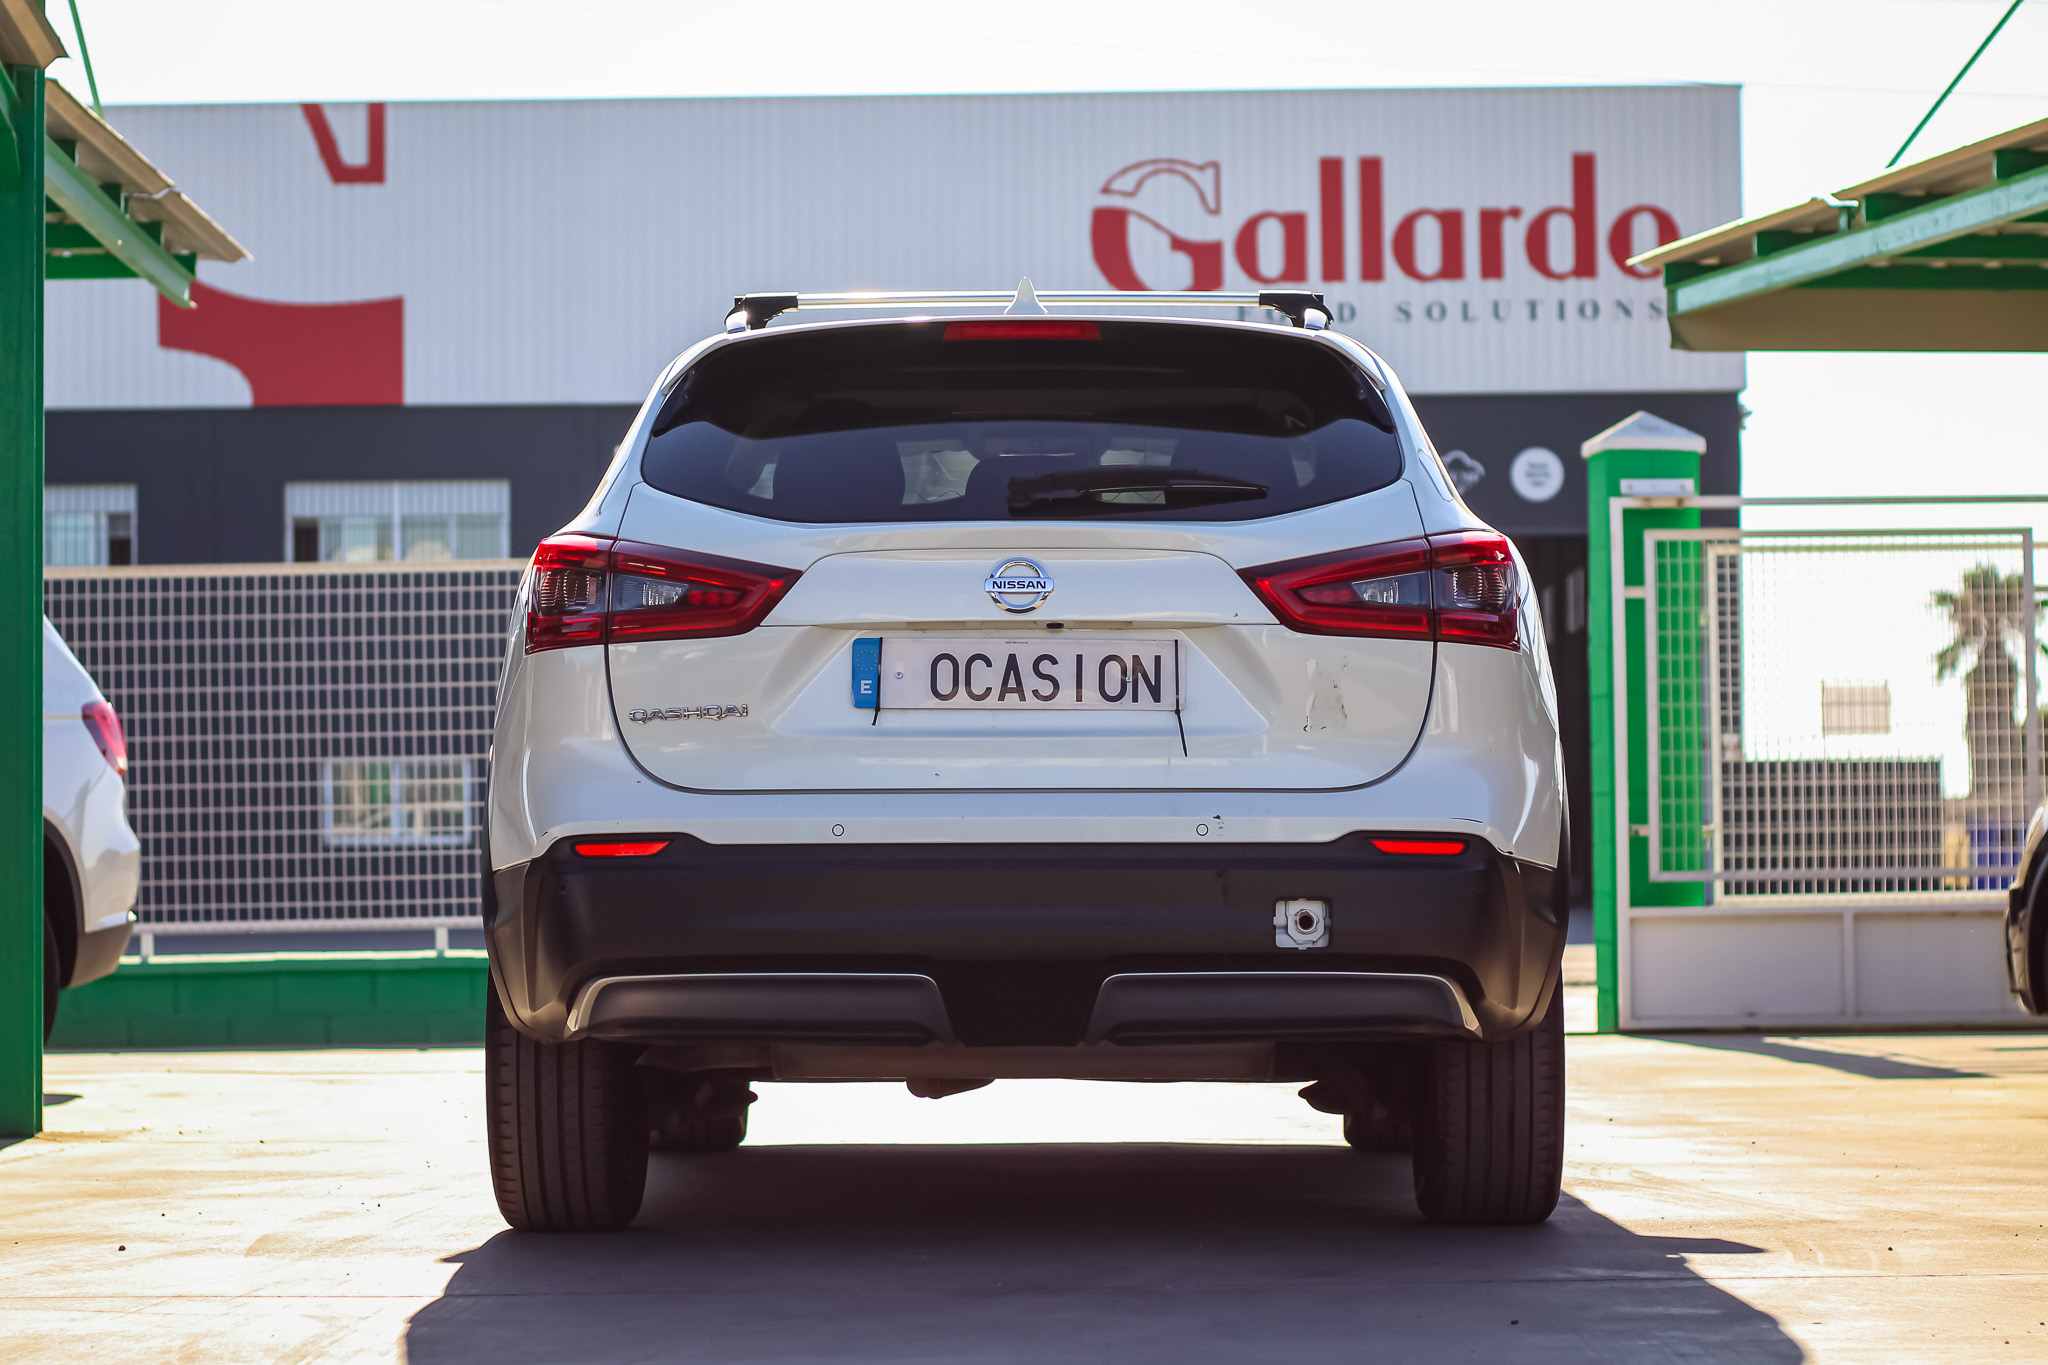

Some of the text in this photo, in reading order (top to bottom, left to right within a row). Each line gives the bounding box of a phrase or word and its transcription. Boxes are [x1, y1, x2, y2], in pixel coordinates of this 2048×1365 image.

[1091, 152, 1681, 292] Gallardo
[1394, 297, 1664, 323] SOLUTIONS
[992, 580, 1046, 589] NISSAN
[860, 653, 1162, 703] E OCASION
[629, 704, 749, 725] QASHQAI
